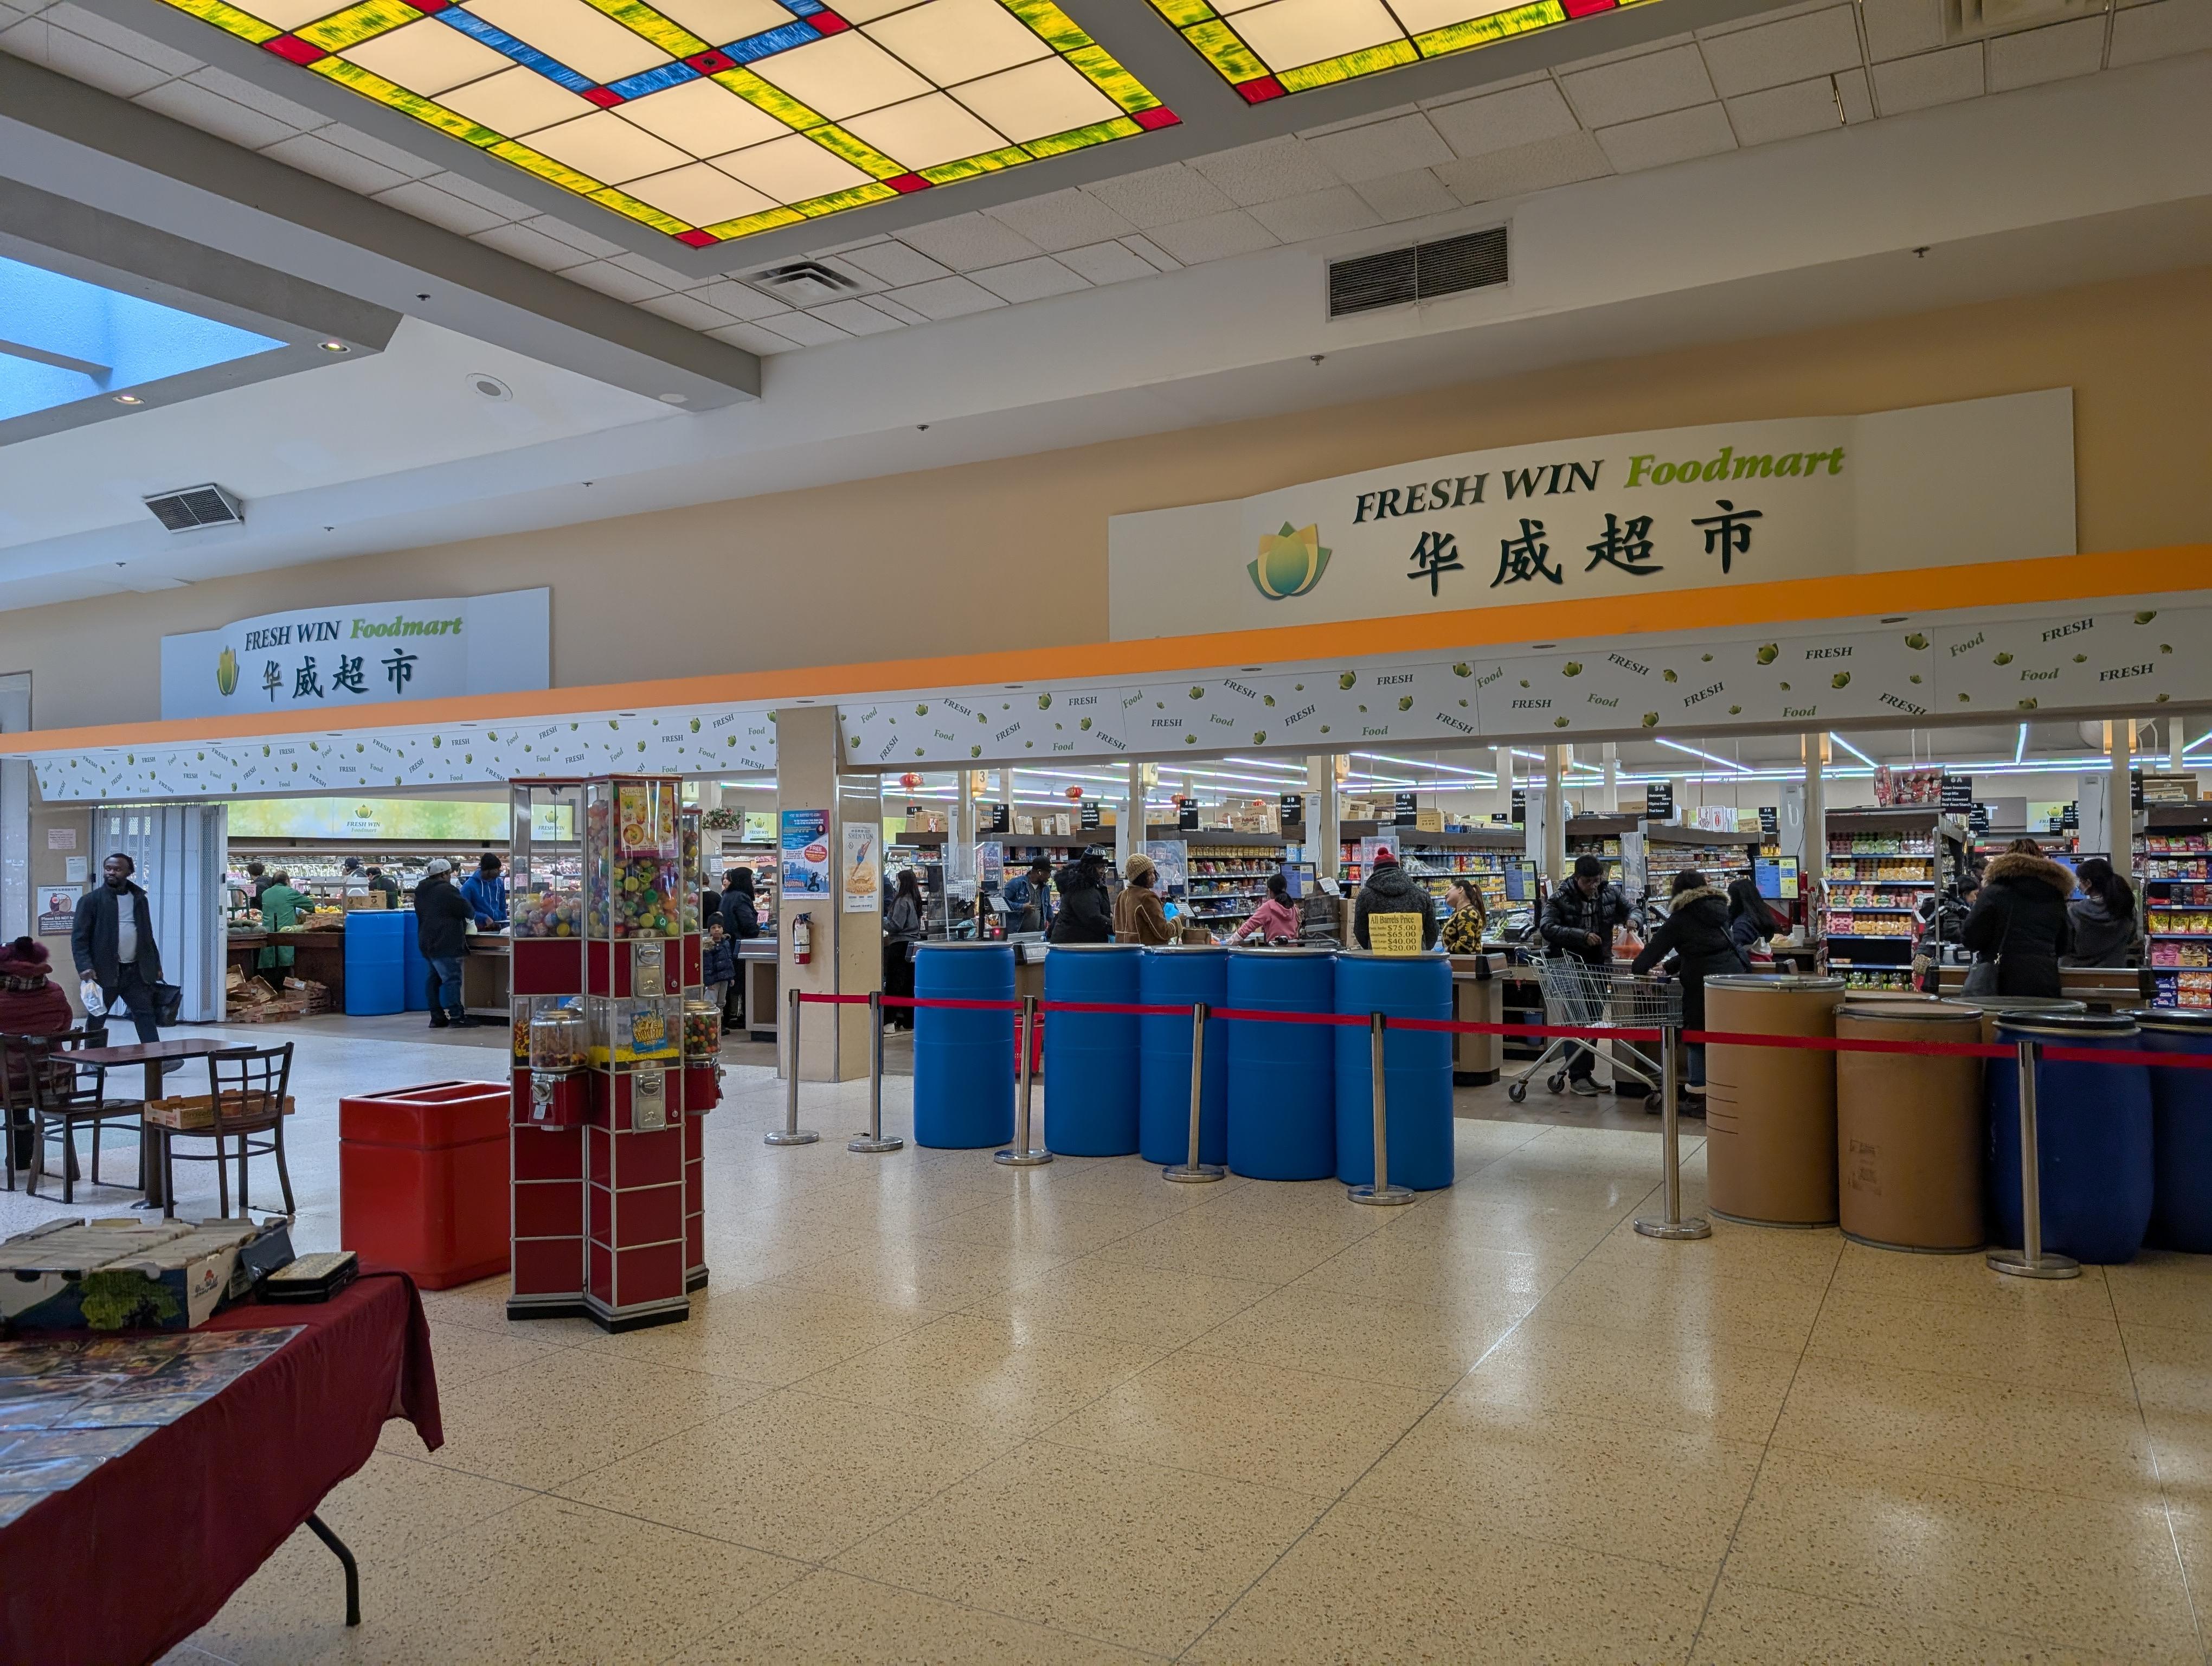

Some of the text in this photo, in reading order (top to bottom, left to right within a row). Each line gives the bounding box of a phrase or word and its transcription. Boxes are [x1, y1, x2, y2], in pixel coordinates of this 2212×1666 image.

[1353, 446, 1845, 524] FRESH WIN Foodmart
[1407, 499, 1763, 597] 华威超市
[245, 616, 463, 650] FRESH WIN Foodmart
[2042, 618, 2093, 642] FRESH
[1950, 632, 1984, 657] Food
[1805, 646, 1852, 659] FRESH
[1608, 653, 1649, 676] FRESH
[262, 648, 417, 702] 华威超市
[1477, 667, 1503, 688] Food
[2020, 668, 2059, 681] Food
[2099, 663, 2153, 681] FRESH
[1377, 674, 1413, 685] FRESH
[1223, 678, 1257, 700] FRESH
[1684, 682, 1724, 707] FRESH
[1069, 696, 1097, 706] FRESH
[1122, 690, 1143, 709] Food
[1512, 699, 1552, 709] FRESH
[1587, 693, 1618, 708] Food
[1879, 693, 1927, 714] FRESH
[944, 699, 972, 716] FRESH
[1783, 706, 1816, 718] Food
[713, 714, 734, 728] FRESH
[861, 707, 877, 723] Food
[1210, 713, 1234, 727] Food
[1284, 704, 1316, 727] FRESH
[1152, 719, 1182, 727] FRESH
[1436, 712, 1474, 735] FRESH
[539, 726, 557, 739] FRESH
[748, 727, 765, 735] Food
[934, 729, 954, 741] Food
[995, 722, 1021, 742] FRESH
[1362, 725, 1388, 736] Food
[506, 732, 519, 746] Food
[662, 735, 683, 743] FRESH
[1096, 731, 1126, 751] FRESH
[321, 746, 332, 758] Food
[373, 739, 391, 753] FRESH
[879, 735, 899, 761] FRESH
[1053, 742, 1073, 751] Food
[1568, 745, 1572, 758] 6
[212, 748, 228, 761] FRESH
[565, 754, 584, 764] FRESH
[610, 748, 623, 762] Food
[698, 747, 716, 759] Food
[44, 761, 53, 772] Food
[83, 756, 97, 768] FRESH
[168, 754, 177, 766] Food
[409, 758, 424, 773] FRESH
[741, 758, 764, 770] FRESH
[1343, 755, 1348, 767] 5
[243, 766, 256, 780] FRESH
[370, 764, 383, 772] Food
[485, 767, 505, 781] FRESH
[1150, 764, 1156, 776] 4
[82, 777, 92, 785] Food
[111, 773, 123, 786] FRESH
[210, 771, 222, 779] Food
[309, 773, 326, 787] FRESH
[980, 771, 985, 783] 3
[57, 781, 66, 798] FRESH
[159, 780, 173, 793] FRESH
[690, 783, 694, 792] 1
[1380, 915, 1399, 924] Barrels
[1400, 915, 1414, 924] Price
